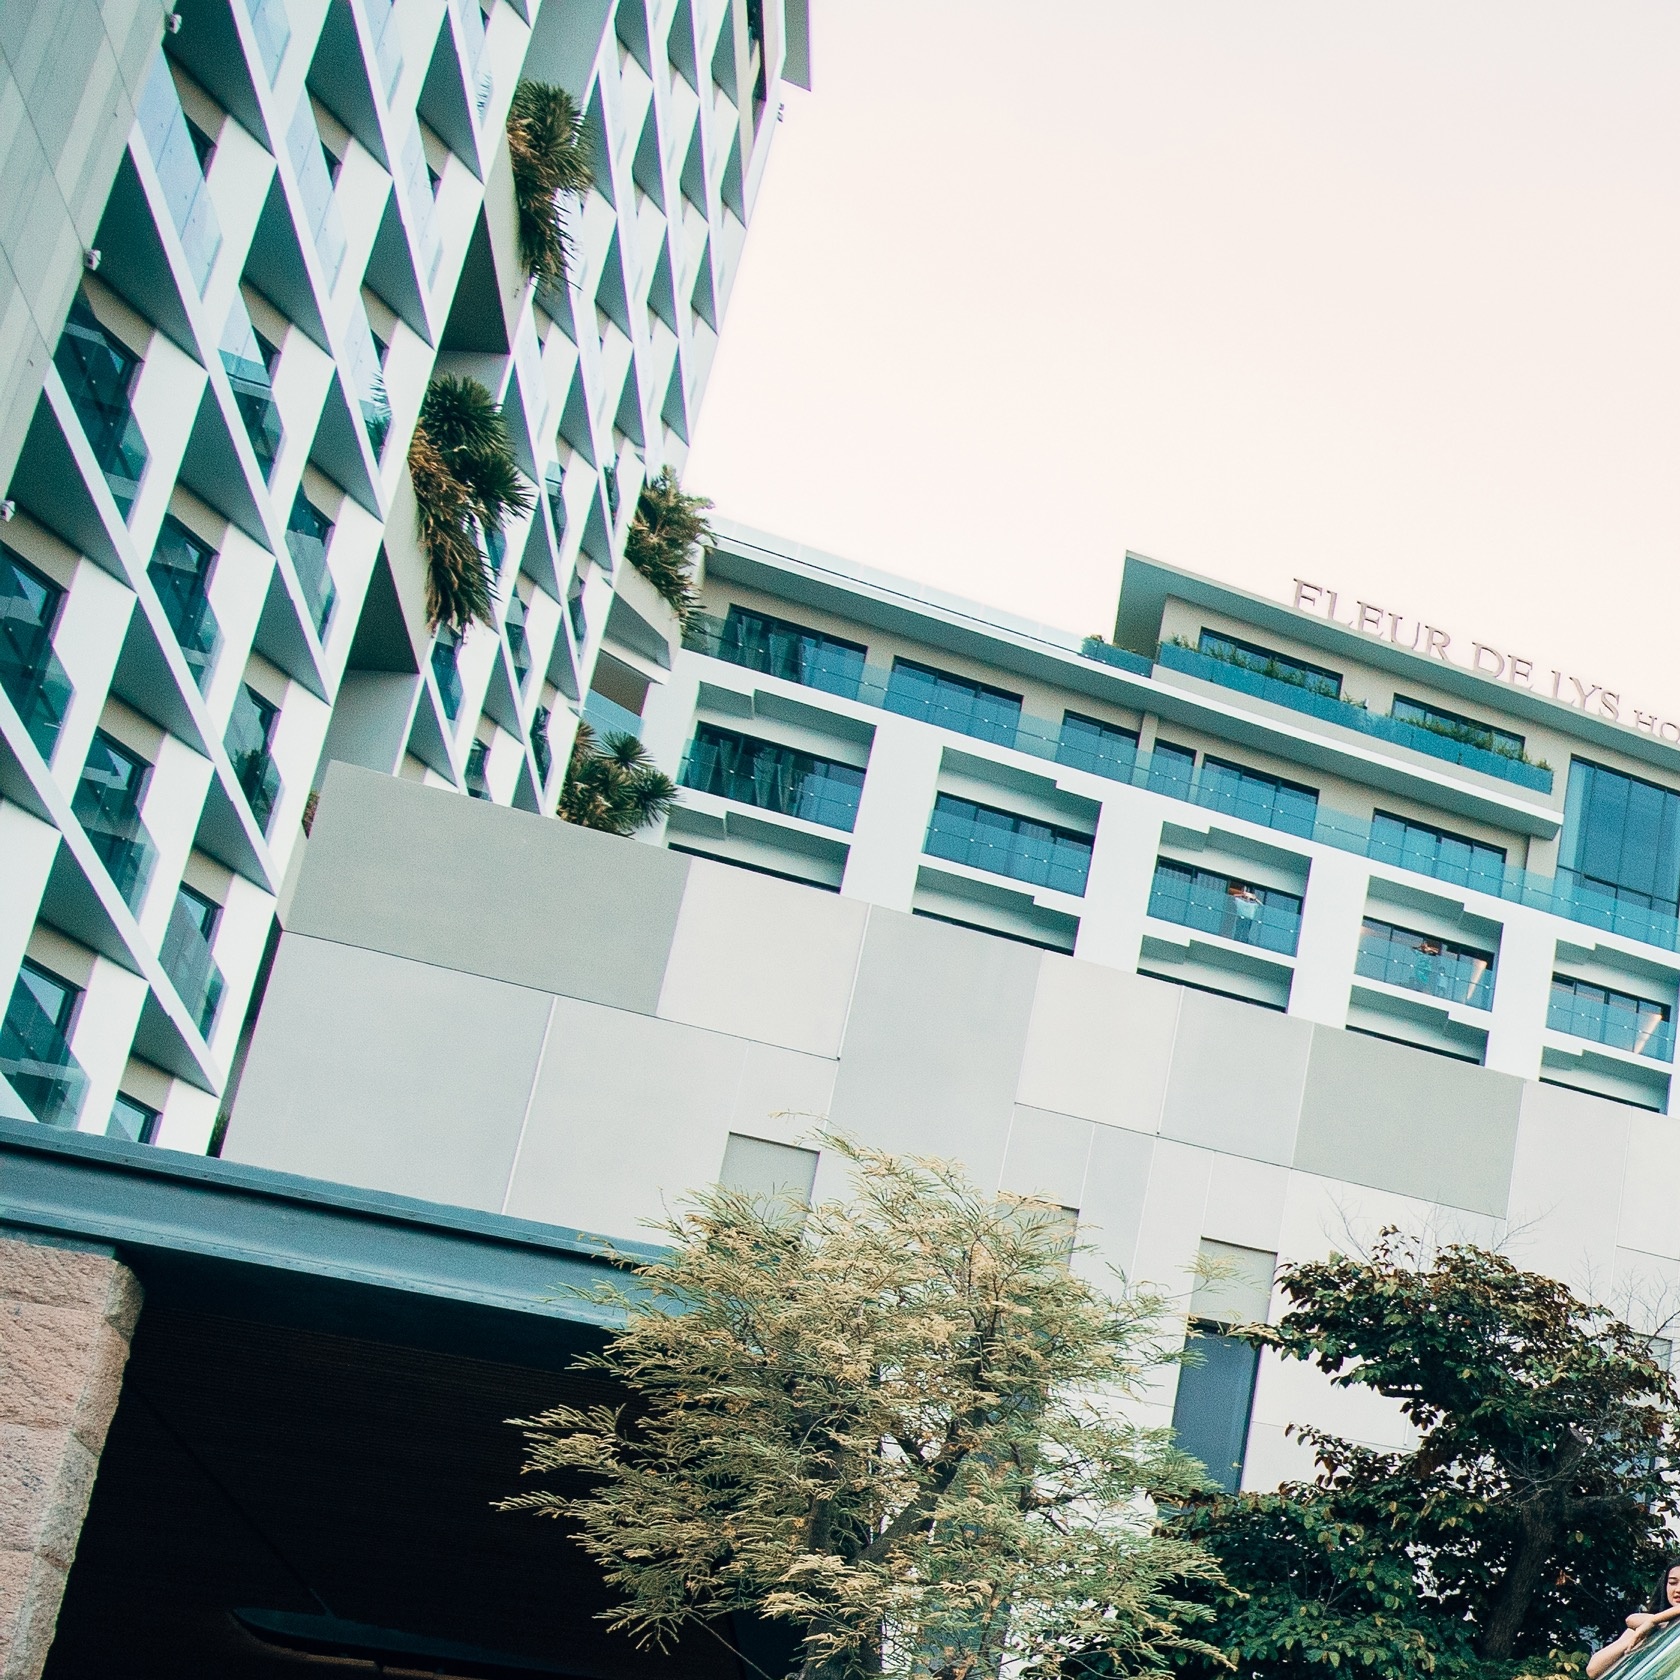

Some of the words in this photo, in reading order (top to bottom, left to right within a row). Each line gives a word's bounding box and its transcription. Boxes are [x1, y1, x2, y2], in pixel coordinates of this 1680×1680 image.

[1293, 578, 1461, 667] FLEUR
[1471, 641, 1535, 691] DE
[1551, 670, 1621, 722] LYS
